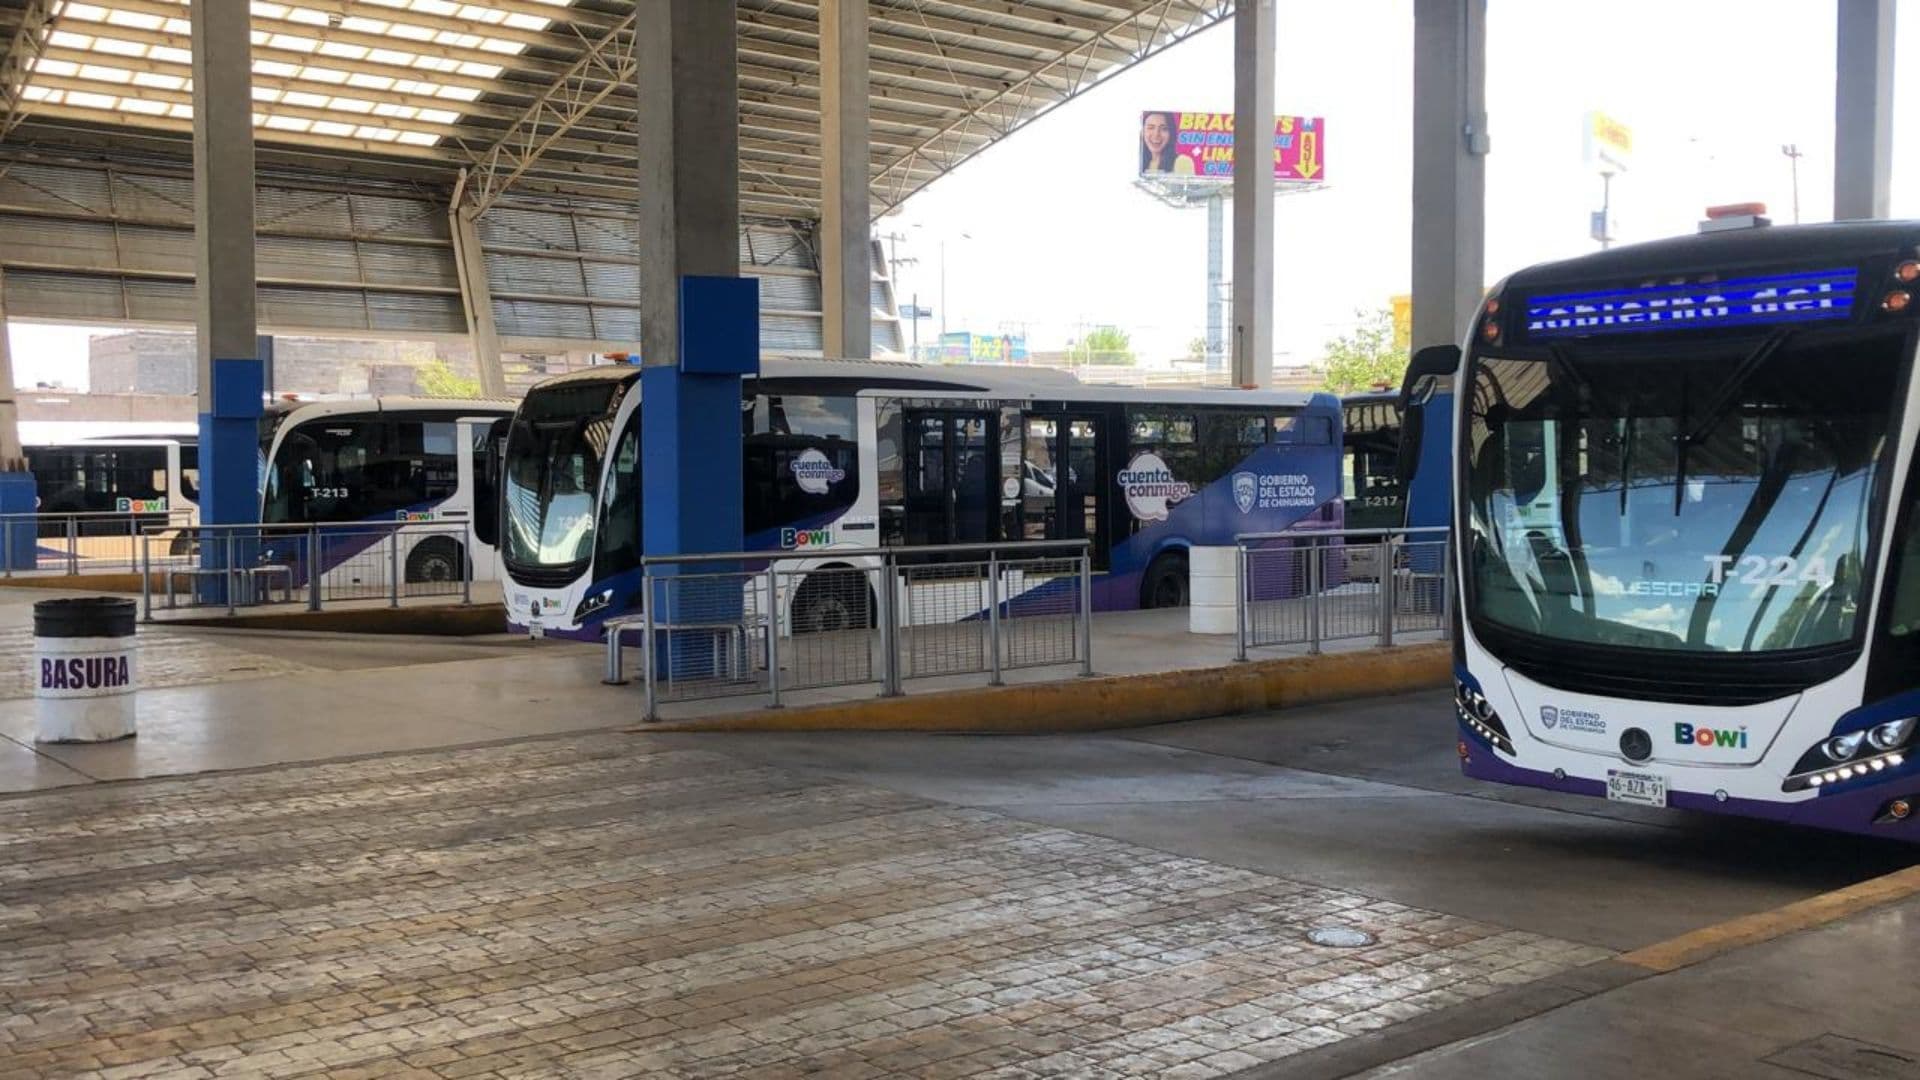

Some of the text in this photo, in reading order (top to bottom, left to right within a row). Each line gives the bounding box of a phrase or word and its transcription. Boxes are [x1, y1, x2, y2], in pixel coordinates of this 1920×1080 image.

[1178, 132, 1205, 144] SIN
[1118, 467, 1172, 483] cuenta
[1259, 475, 1308, 486] GOBIERNO
[312, 488, 349, 498] T-213
[1128, 484, 1189, 500] conmigo
[1259, 485, 1315, 498] DEL ESTADO
[1259, 499, 1270, 507] DE
[1365, 496, 1398, 507] T-217
[782, 527, 831, 547] Bowi
[1703, 555, 1831, 586] T-224
[41, 655, 129, 689] BASURA
[1560, 709, 1600, 720] GOBIERNO
[1560, 716, 1606, 728] DEL ESTADO
[1675, 722, 1747, 749] Bowi
